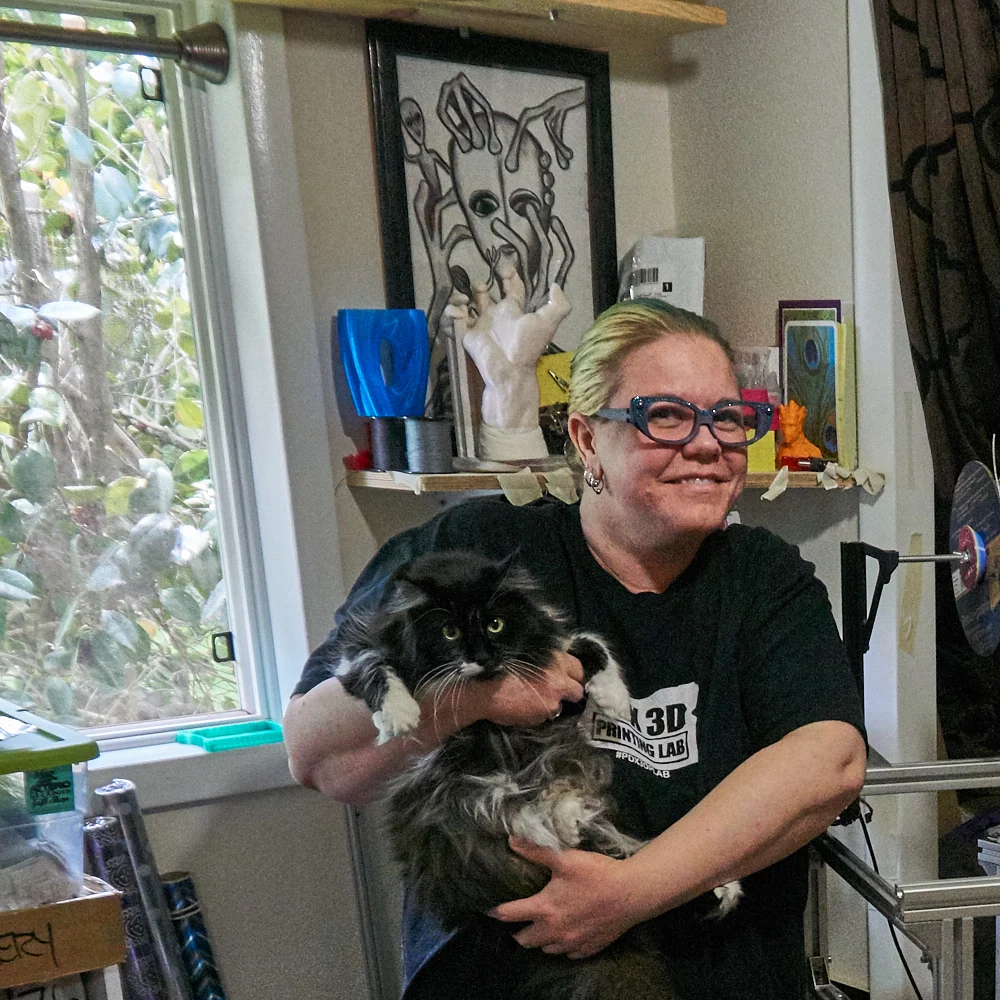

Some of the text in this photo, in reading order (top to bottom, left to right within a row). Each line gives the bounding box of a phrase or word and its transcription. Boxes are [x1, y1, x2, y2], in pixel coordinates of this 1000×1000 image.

[646, 703, 687, 737] 3D
[595, 718, 655, 758] PRINTING
[658, 739, 685, 758] LAB
